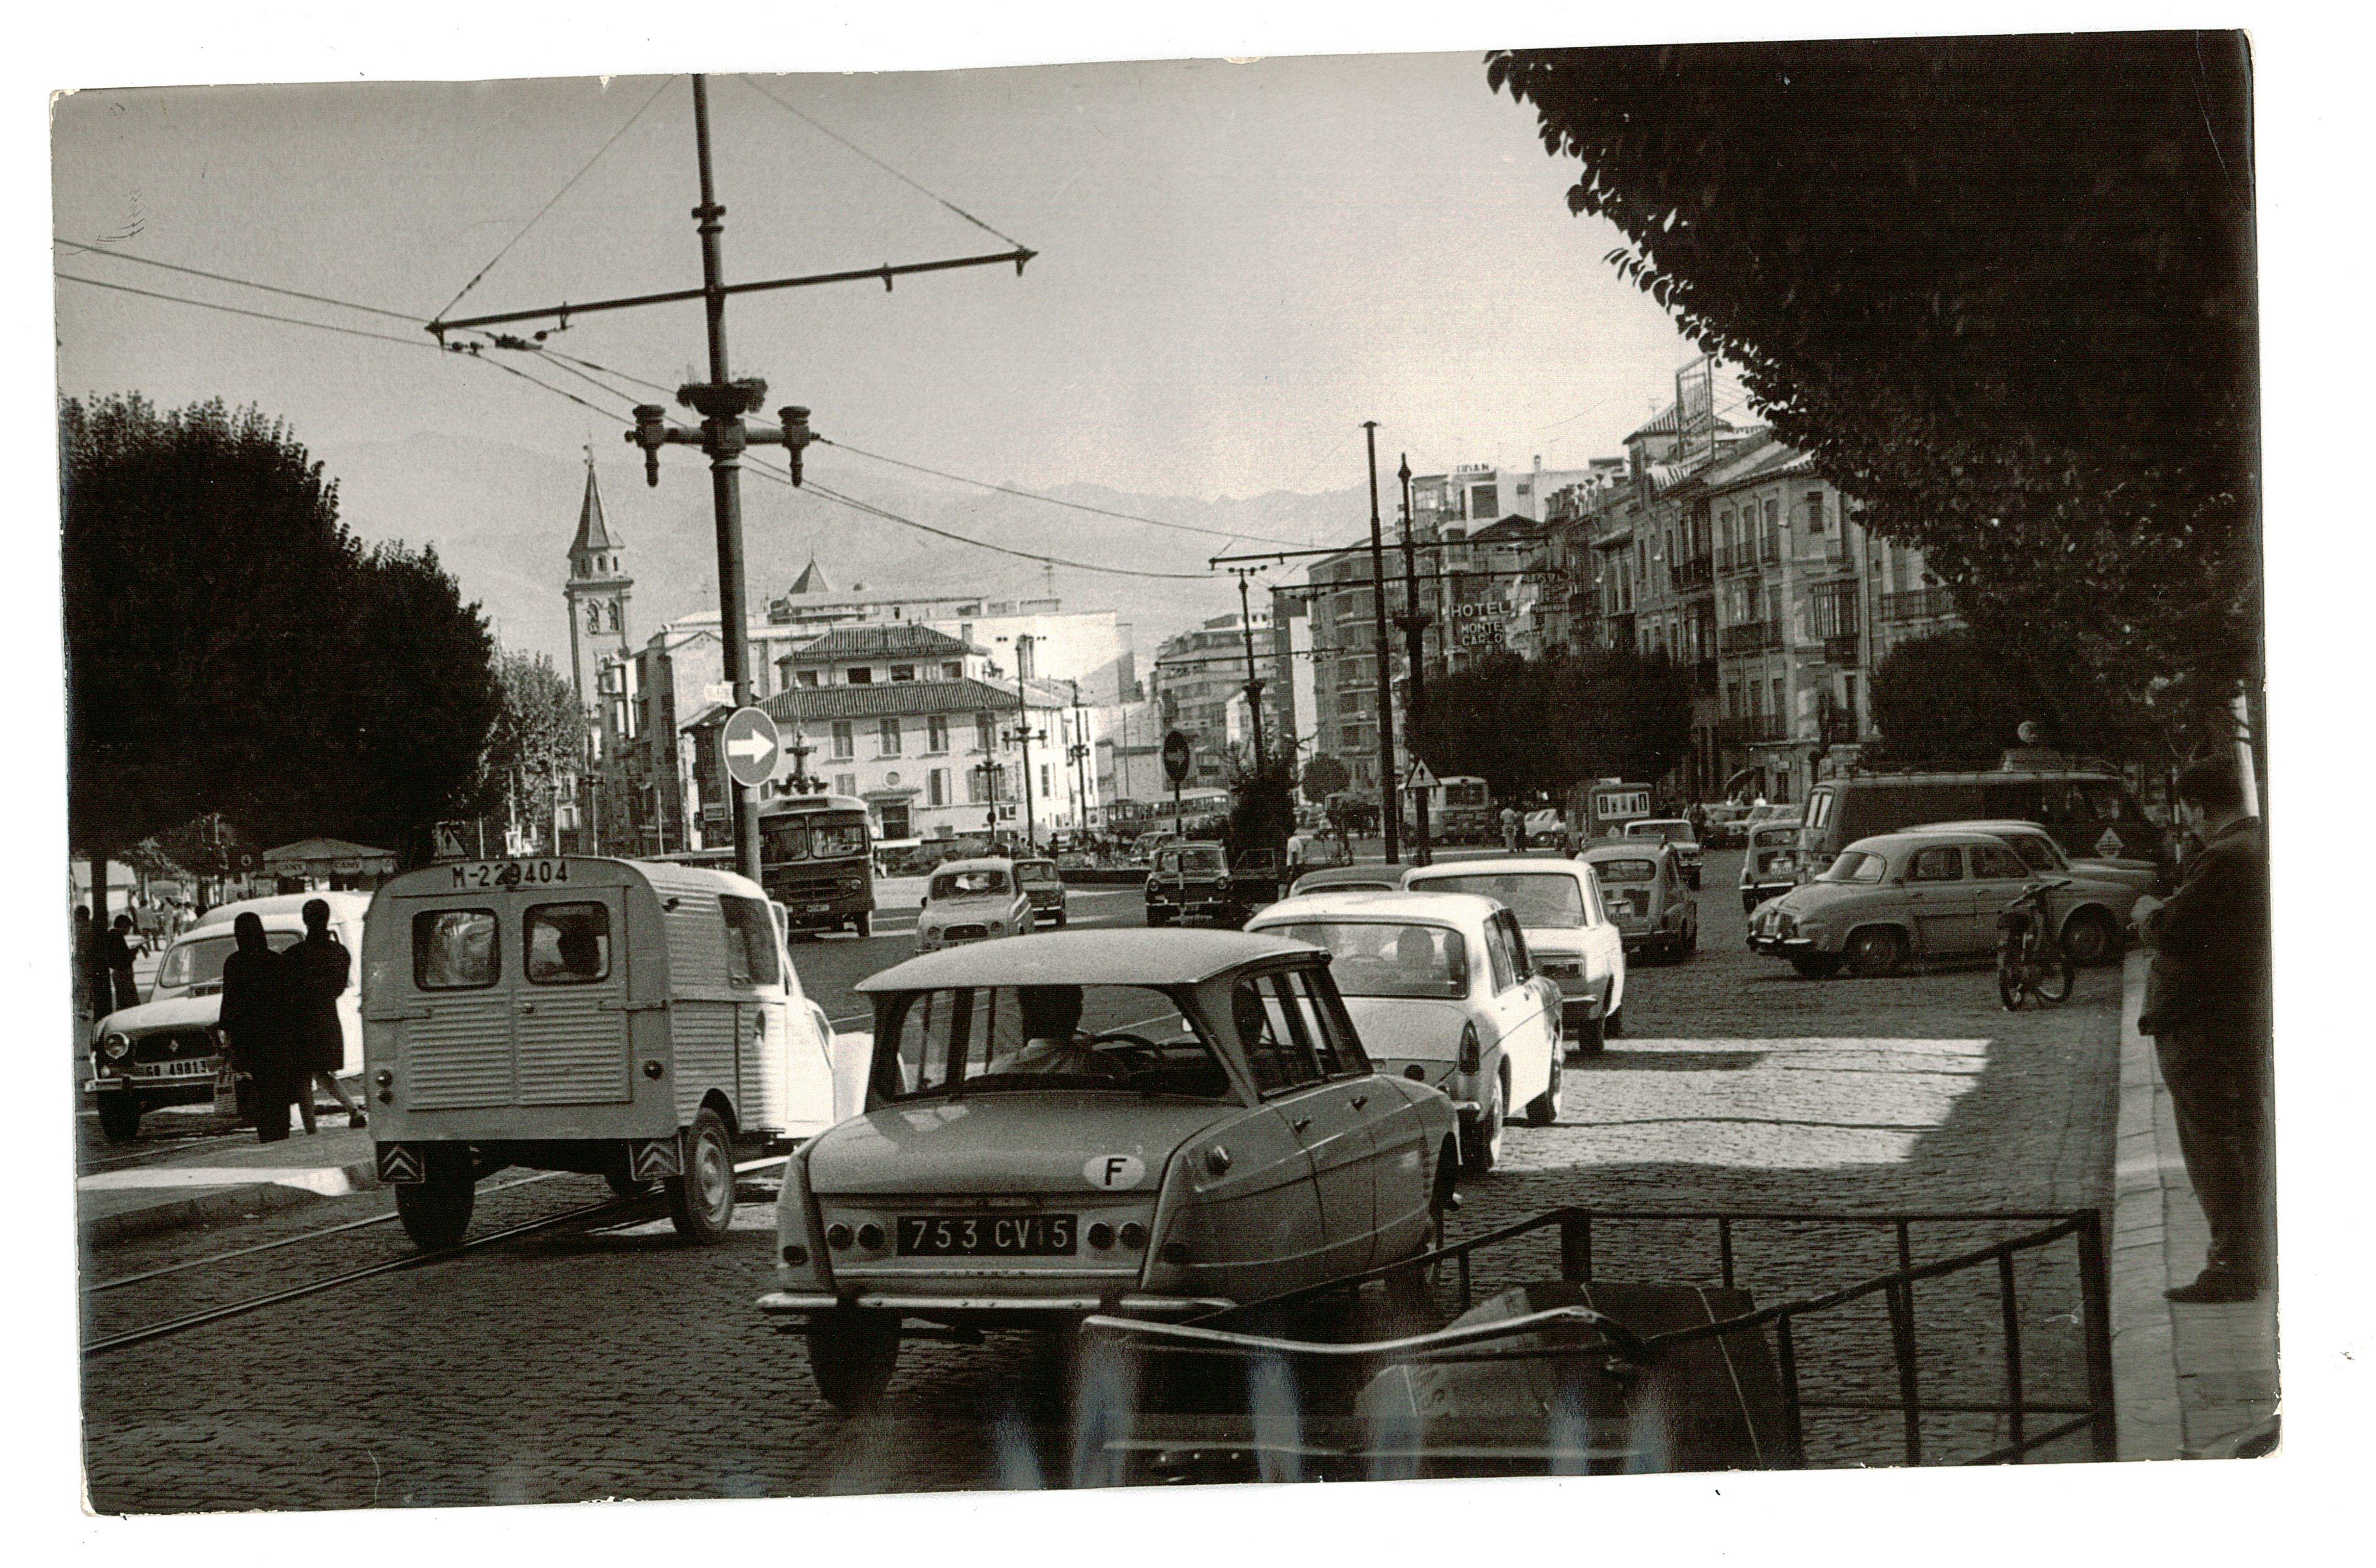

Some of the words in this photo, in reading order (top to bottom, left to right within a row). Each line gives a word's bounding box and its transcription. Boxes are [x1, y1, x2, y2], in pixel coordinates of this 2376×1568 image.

[1451, 602, 1509, 617] HOTEL
[1461, 622, 1503, 634] MONTE
[1105, 1157, 1127, 1186] F
[912, 1219, 977, 1249] 753
